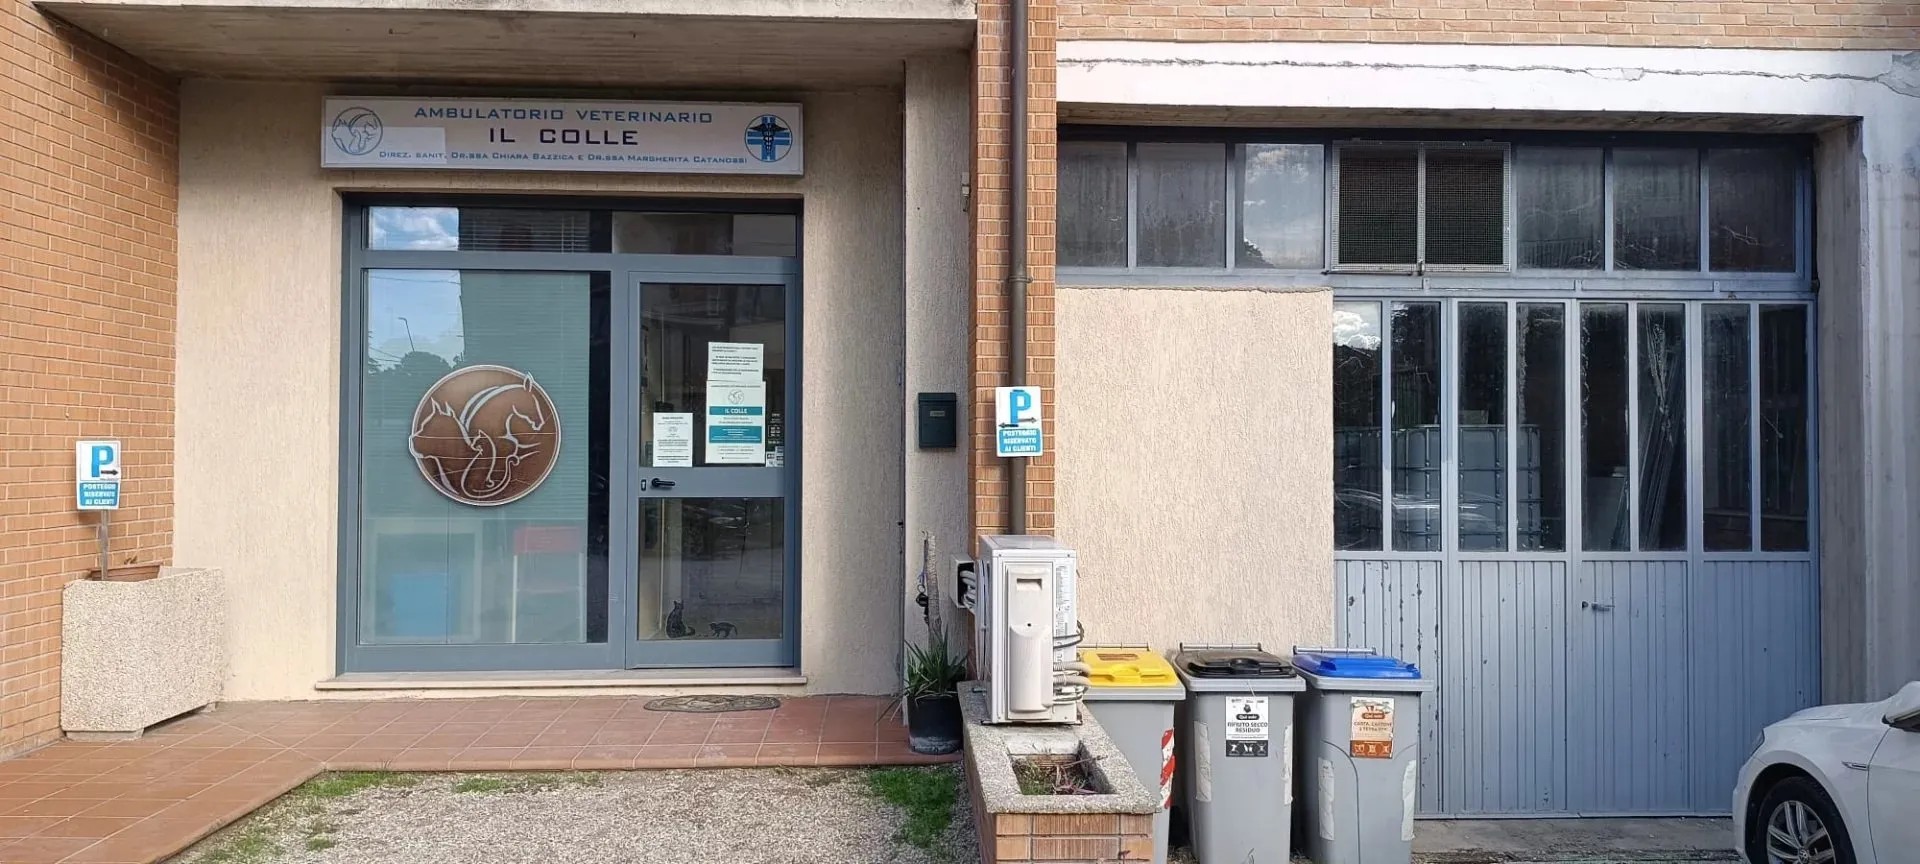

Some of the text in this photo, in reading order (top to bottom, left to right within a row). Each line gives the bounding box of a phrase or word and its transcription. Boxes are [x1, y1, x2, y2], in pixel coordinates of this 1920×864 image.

[414, 107, 713, 124] AMBULATORIO VETERINARIO
[489, 127, 639, 146] IL COLLE
[1010, 390, 1031, 424] P
[92, 446, 113, 477] P
